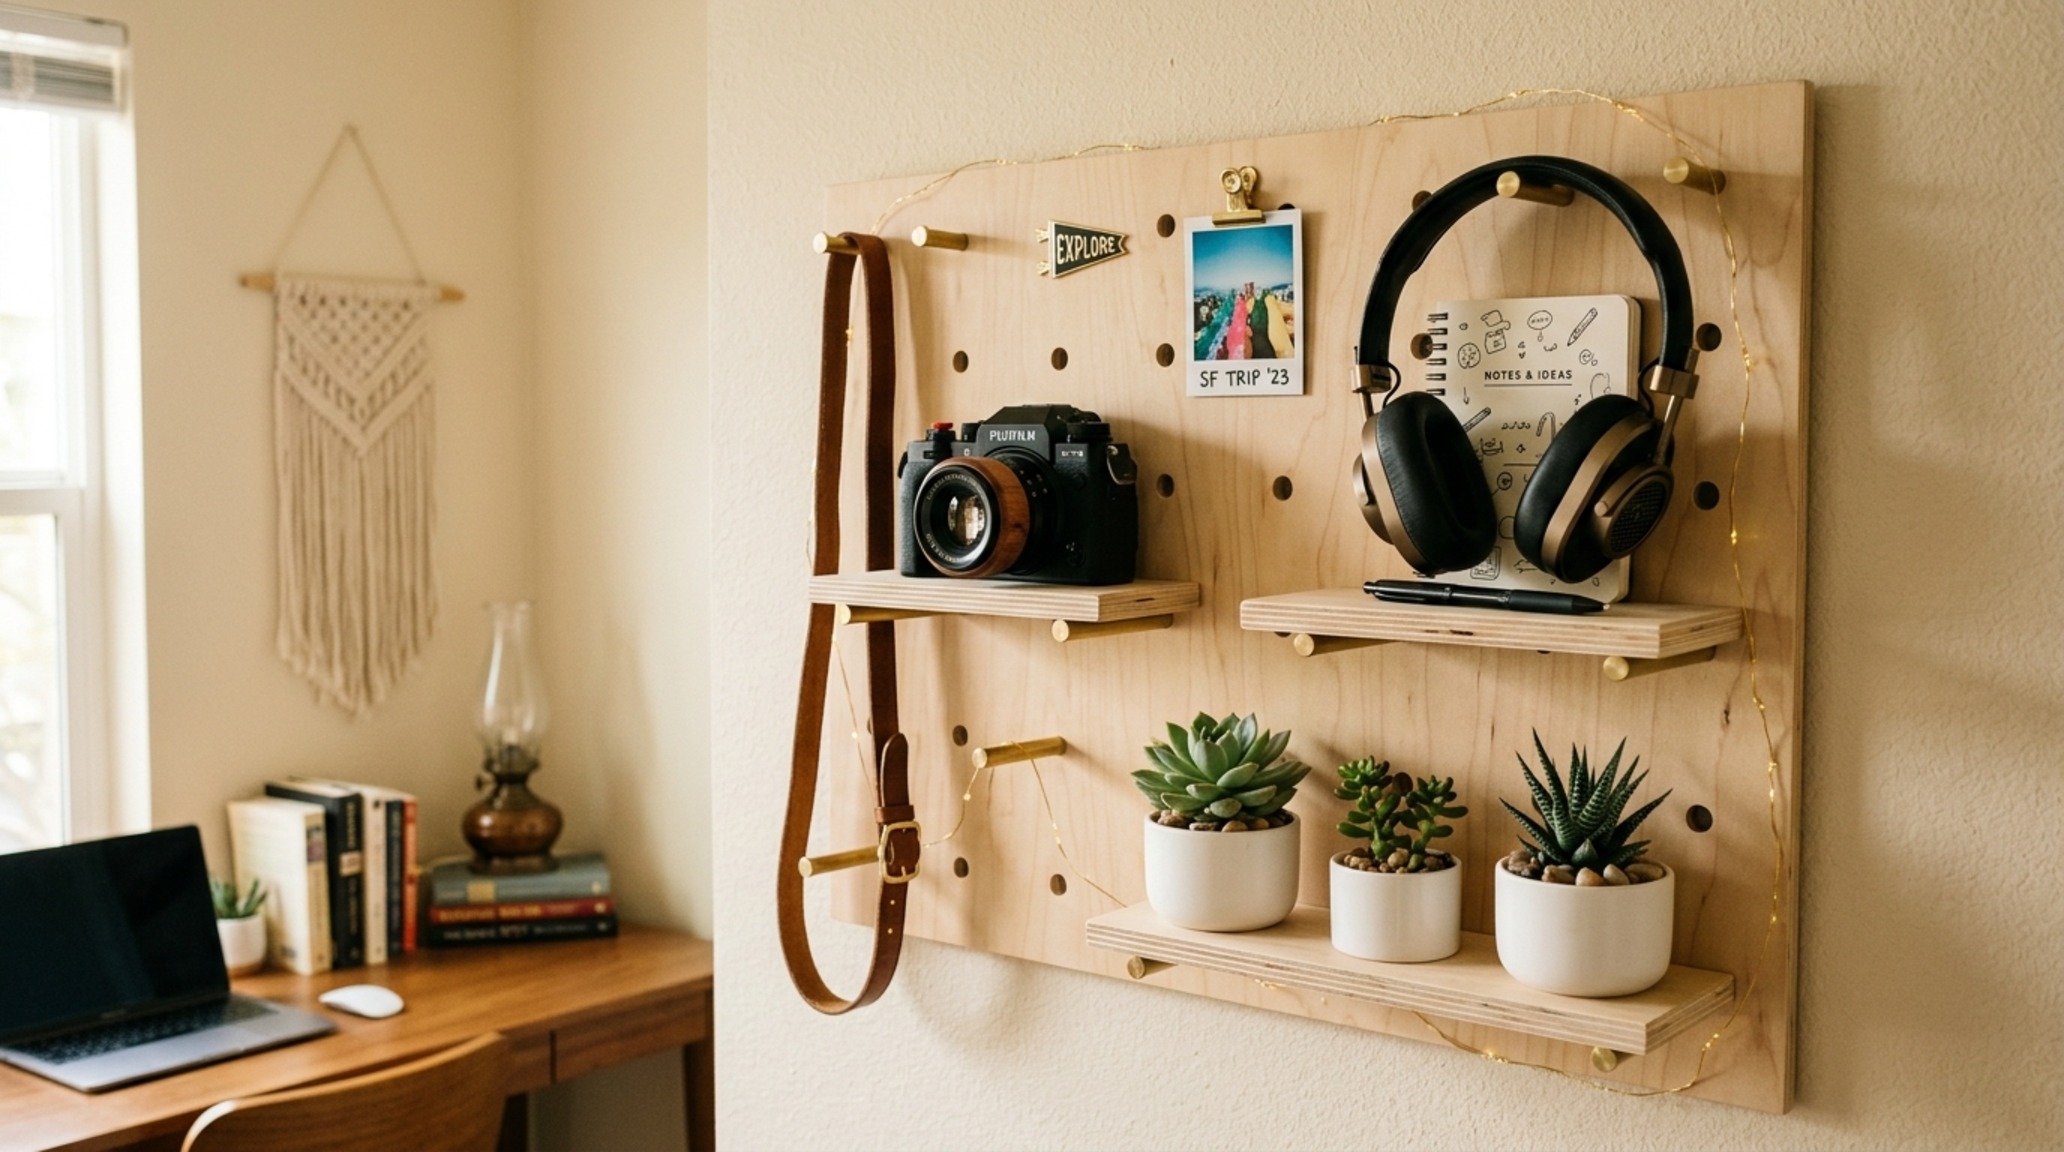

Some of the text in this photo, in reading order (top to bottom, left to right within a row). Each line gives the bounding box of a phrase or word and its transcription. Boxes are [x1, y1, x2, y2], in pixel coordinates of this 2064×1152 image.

[1056, 233, 1116, 265] EXPLORE
[1200, 366, 1290, 388] SF TRIP '23
[1484, 369, 1573, 380] NOTES & IDEAS
